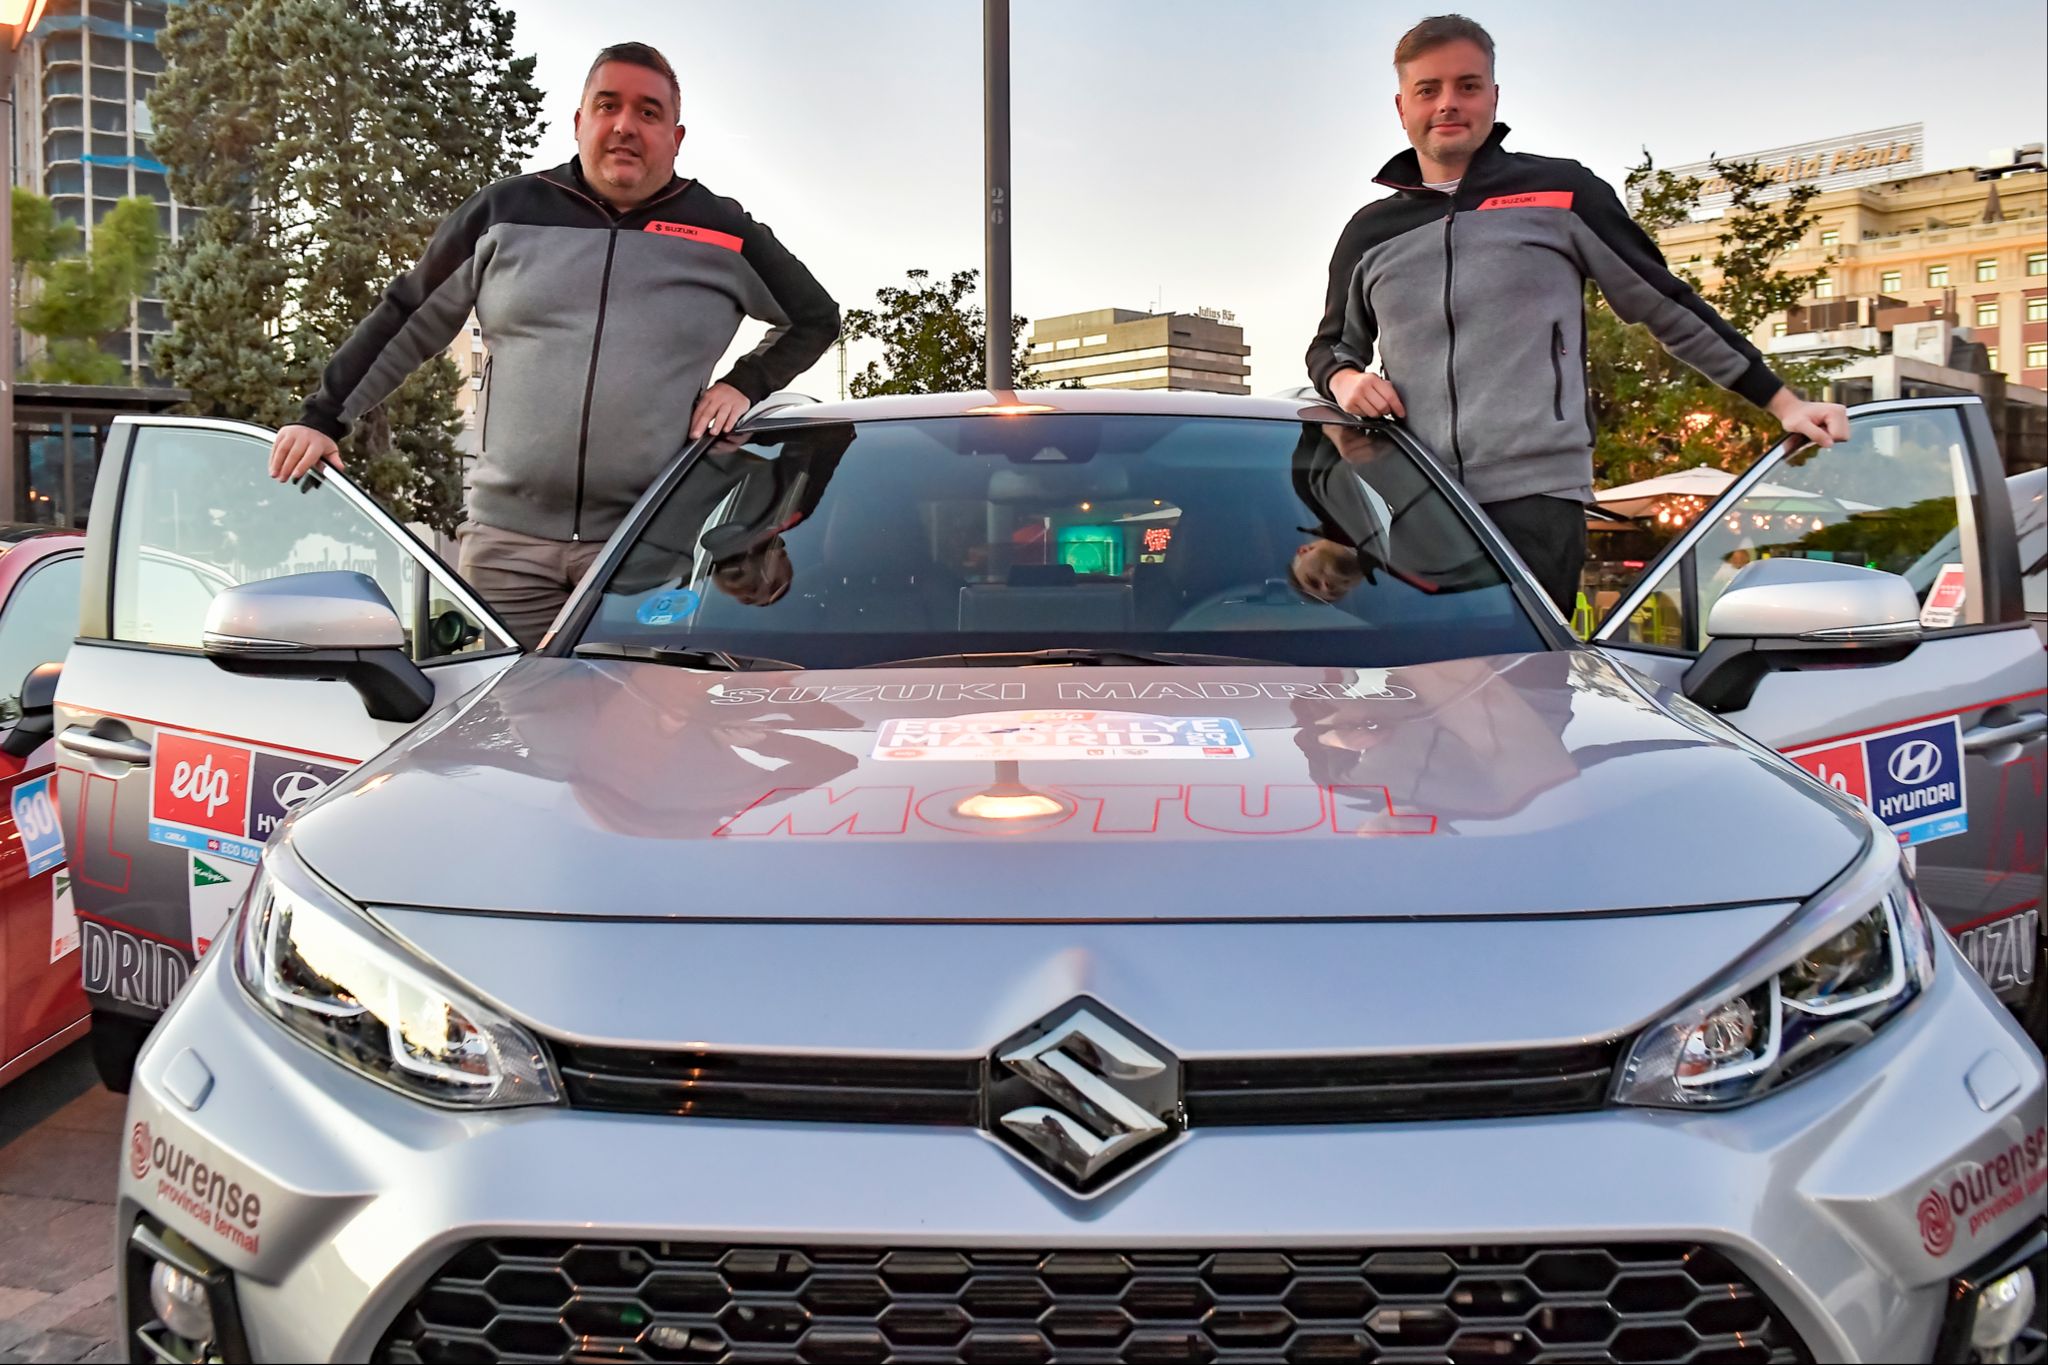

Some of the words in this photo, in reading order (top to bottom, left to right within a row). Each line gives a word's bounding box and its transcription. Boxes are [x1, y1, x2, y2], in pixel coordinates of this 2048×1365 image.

[1829, 142, 1912, 174] Fénix
[1501, 196, 1536, 204] SUZUKI
[664, 225, 698, 235] SUZUKI
[711, 683, 1026, 705] SUZUKI
[1058, 681, 1417, 701] MADRID
[889, 732, 1175, 747] MADRID
[895, 720, 1001, 734] ECO
[1022, 719, 1225, 733] RALLYE
[170, 754, 229, 818] edp
[1879, 782, 1955, 818] HYUNDAI
[19, 790, 54, 842] 30
[712, 783, 1437, 837] MOTUL
[221, 842, 240, 856] ECO
[241, 847, 260, 861] RAL
[152, 1136, 261, 1229] ourense
[158, 1179, 211, 1226] provincia
[214, 1211, 259, 1256] termal
